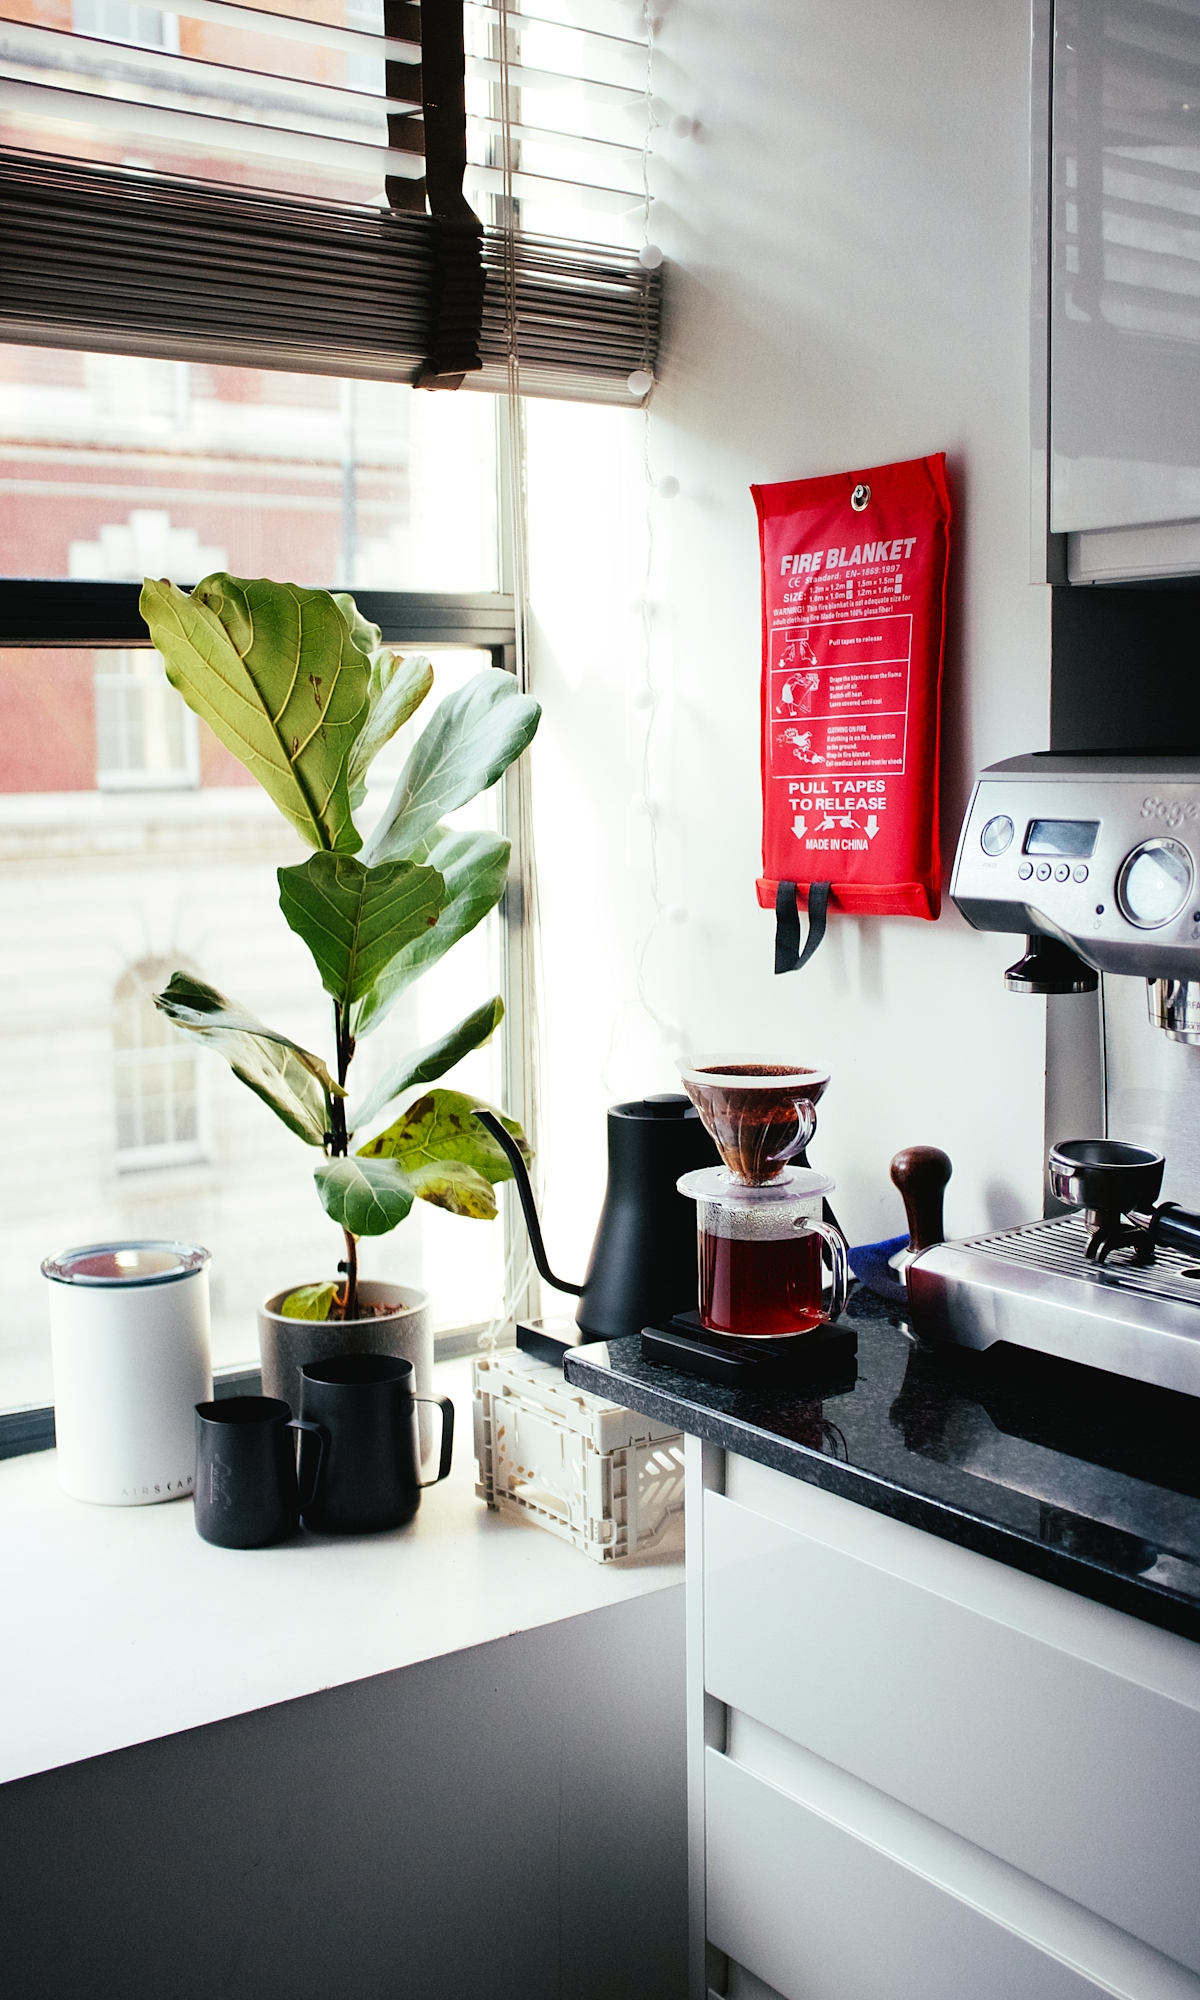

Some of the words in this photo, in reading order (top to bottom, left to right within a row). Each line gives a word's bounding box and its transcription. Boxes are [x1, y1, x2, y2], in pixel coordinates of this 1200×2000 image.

[780, 551, 824, 575] FIRE
[826, 537, 916, 569] BLANKET
[805, 572, 841, 584] Standard:
[783, 591, 806, 603] SIZE:
[864, 596, 889, 605] adequate
[789, 782, 828, 794] PULL
[832, 780, 886, 793] TAPES
[788, 798, 812, 810] TO
[816, 798, 886, 810] RELEASE
[1140, 796, 1198, 828] Sage
[806, 839, 829, 850] MADE
[830, 839, 840, 850] IN
[841, 839, 868, 850] CHINA
[121, 1476, 192, 1496] AIRSCAP
